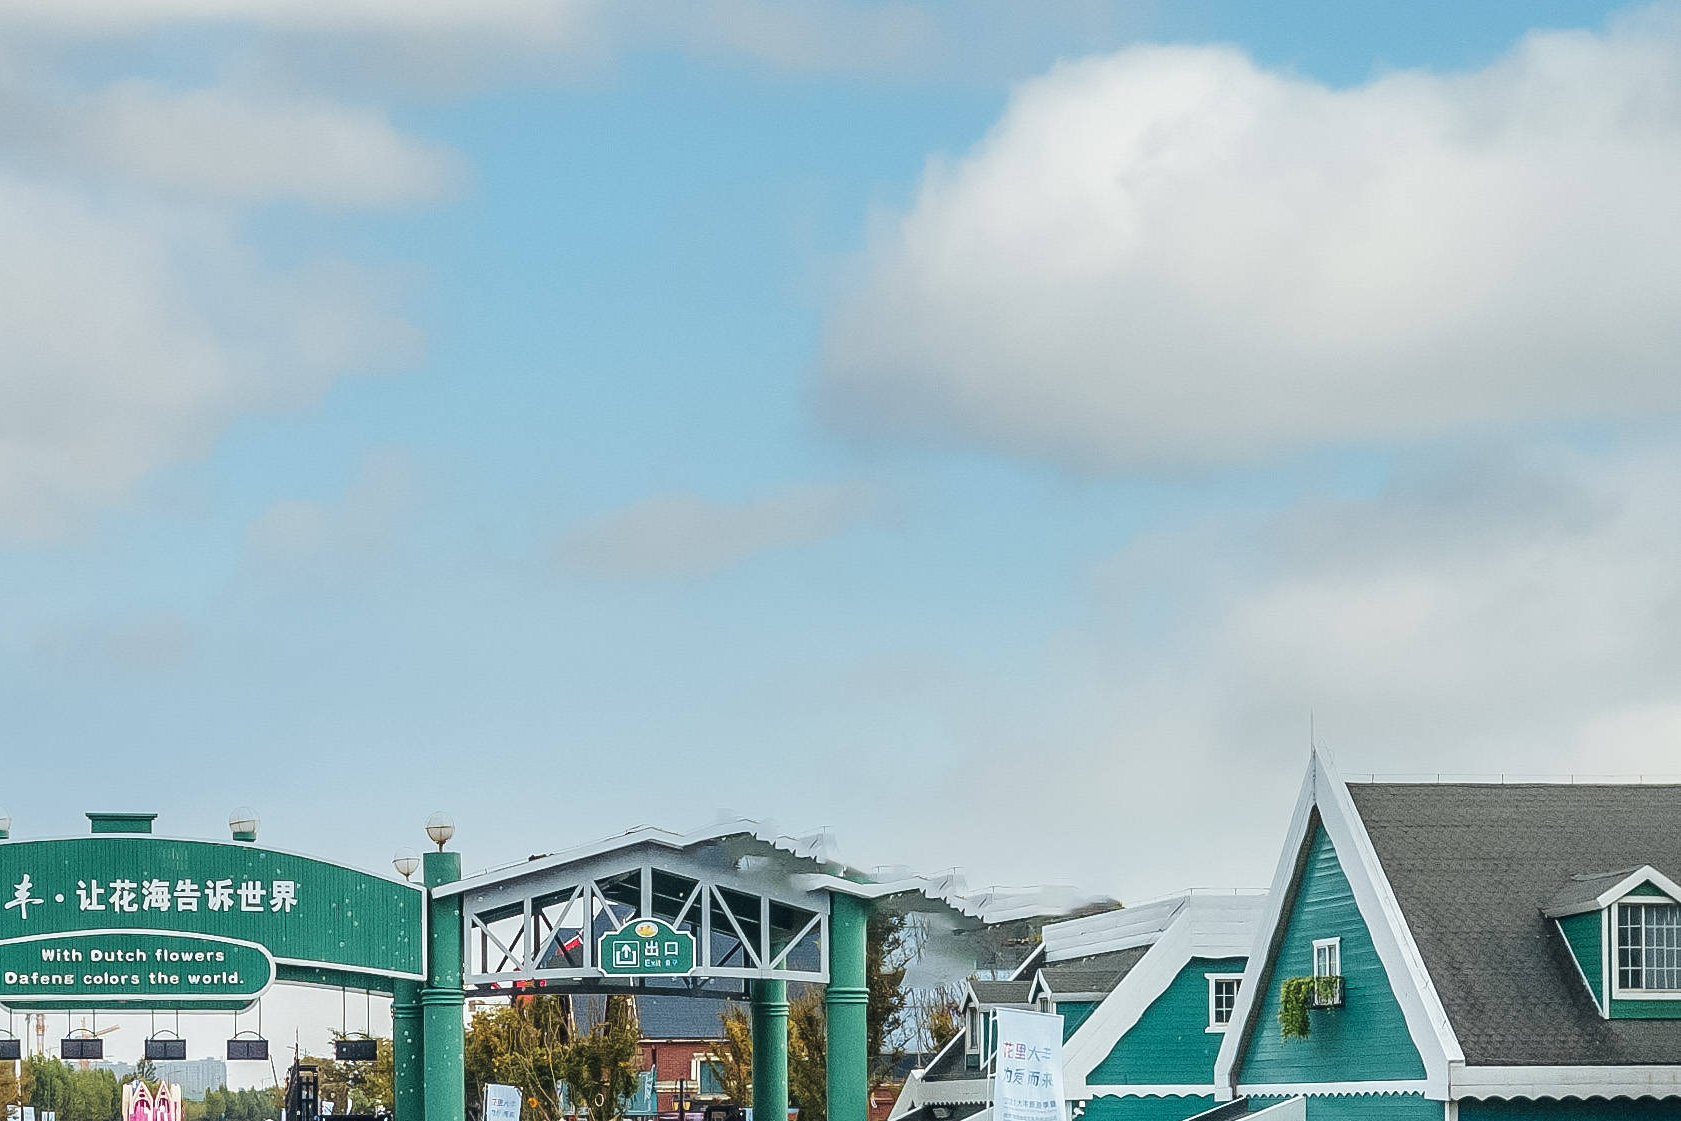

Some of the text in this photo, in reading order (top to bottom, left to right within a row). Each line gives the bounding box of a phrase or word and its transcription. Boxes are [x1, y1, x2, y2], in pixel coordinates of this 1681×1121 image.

[645, 940, 678, 956] 出口
[41, 949, 224, 962] With Dutch flowers
[645, 958, 661, 968] Exit
[4, 971, 244, 985] Dafeng colors the world.
[1002, 1067, 1053, 1088] 为爱而来
